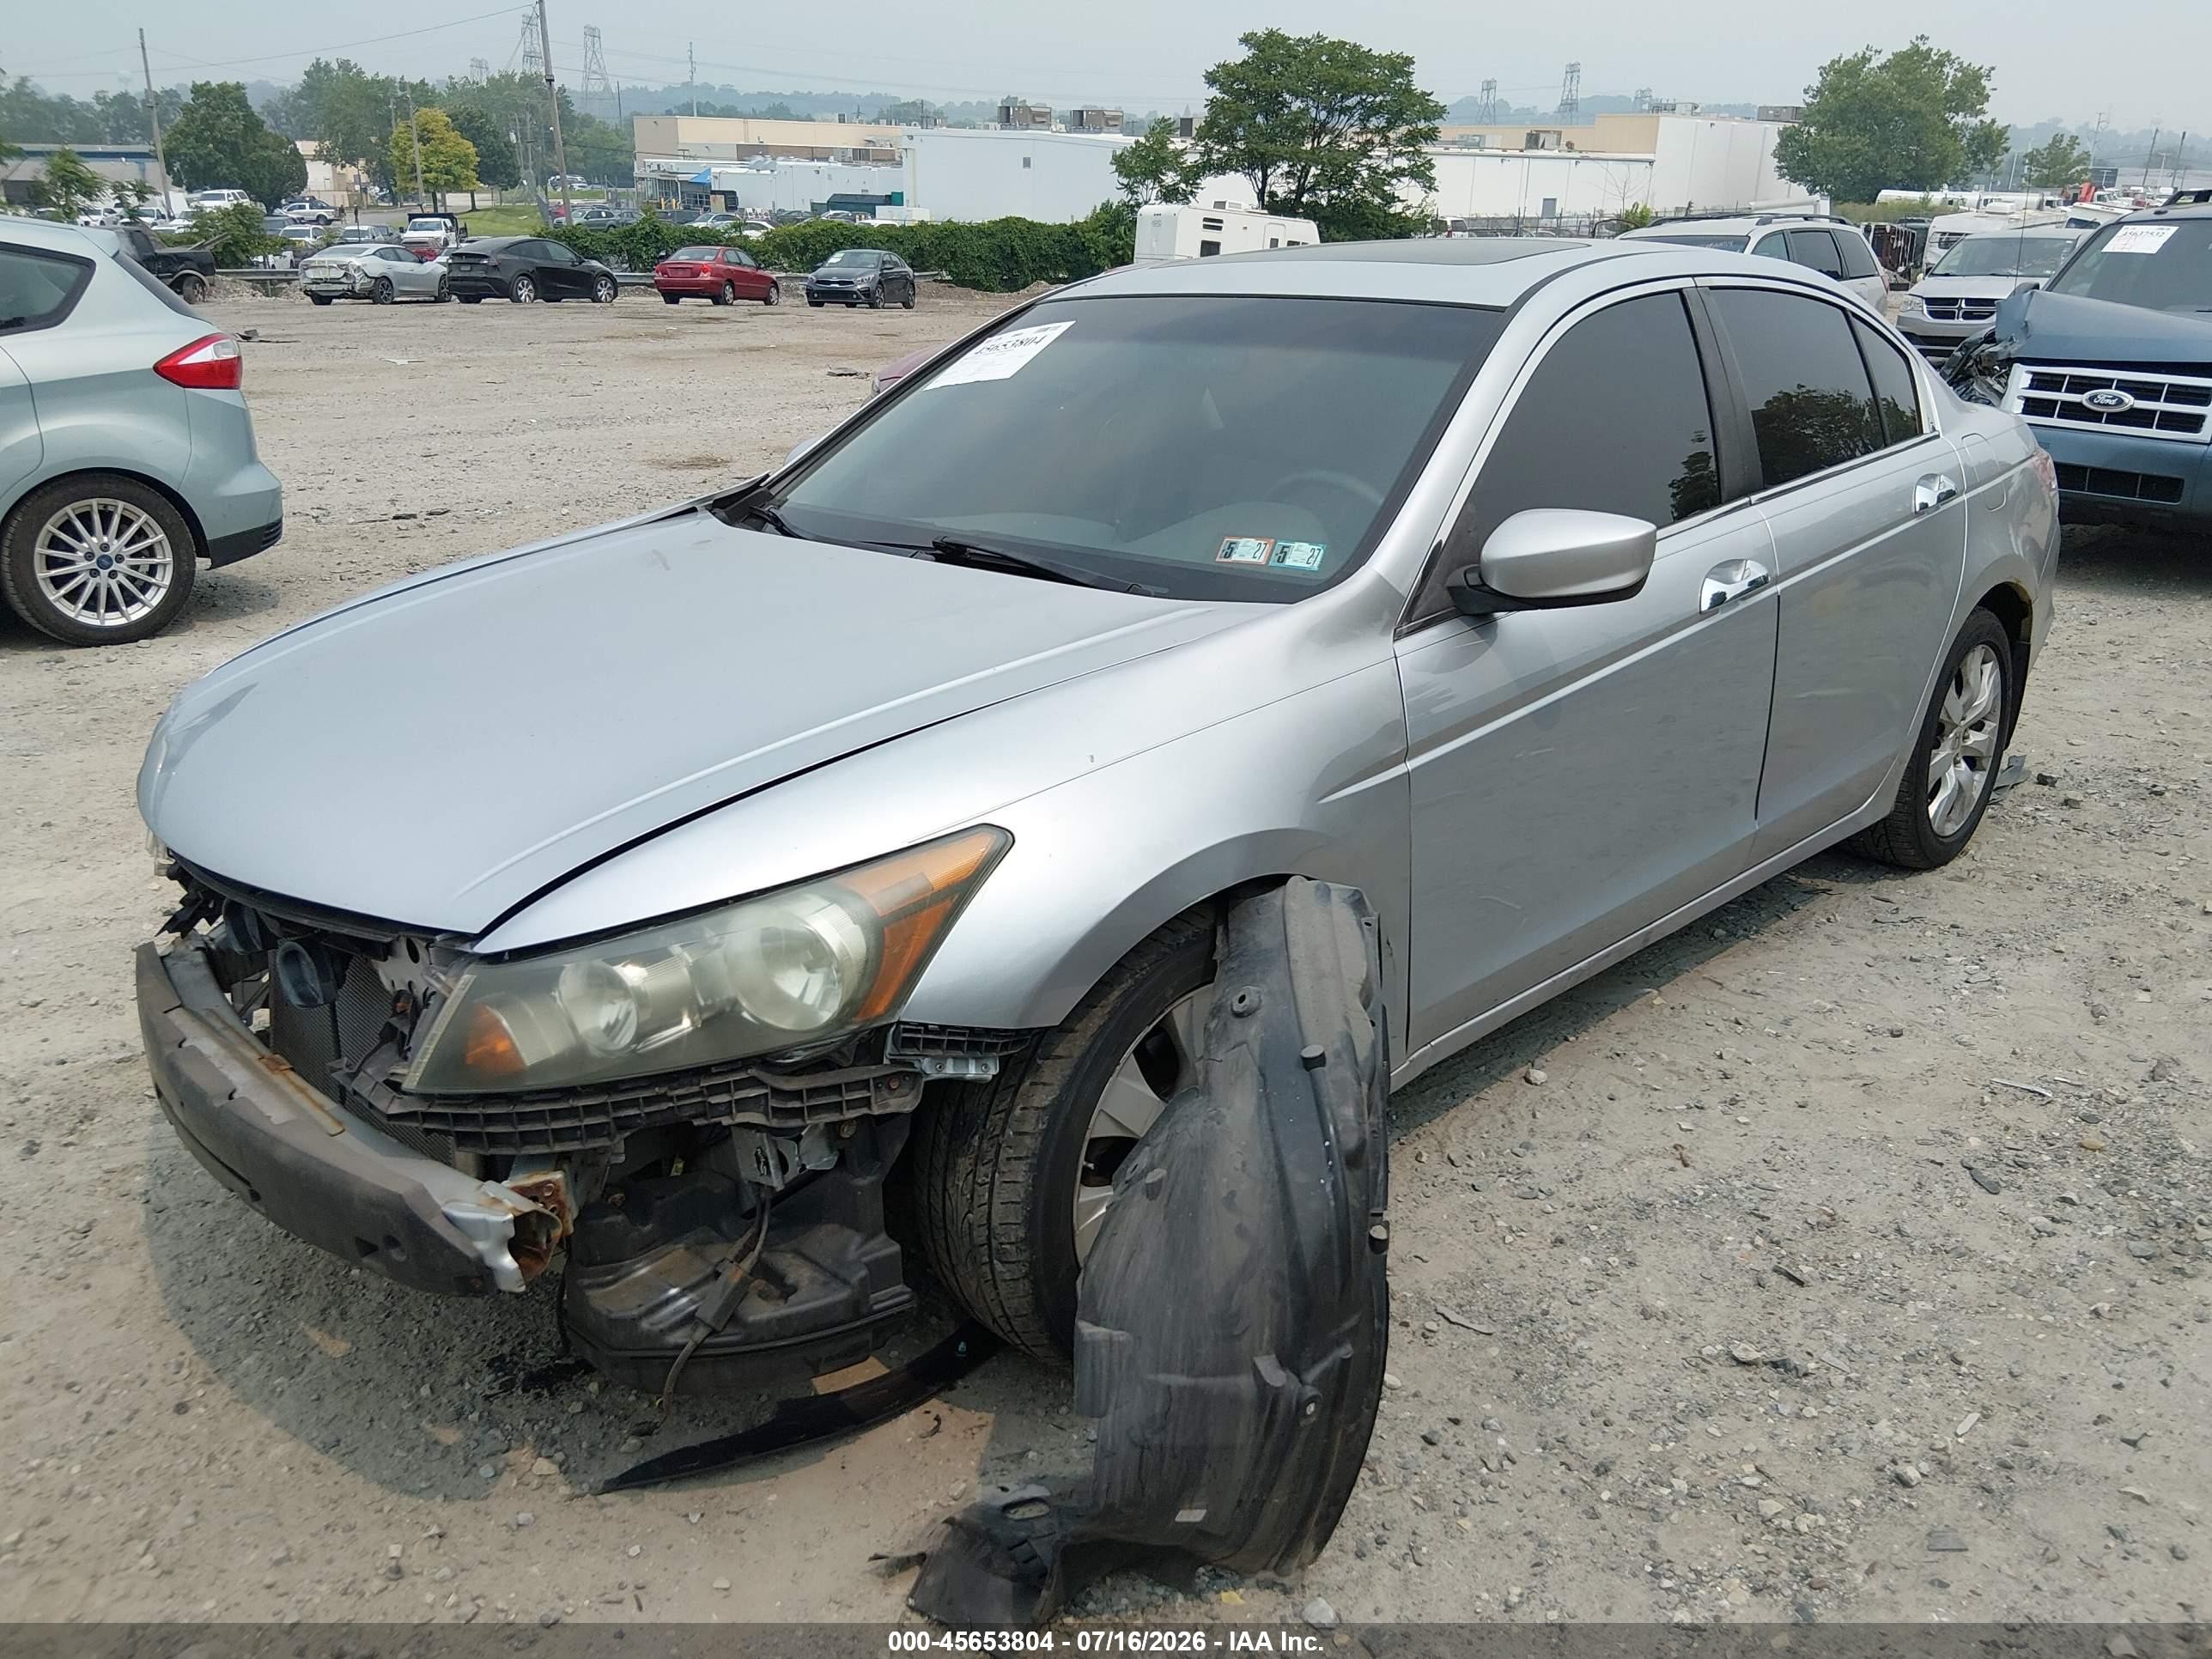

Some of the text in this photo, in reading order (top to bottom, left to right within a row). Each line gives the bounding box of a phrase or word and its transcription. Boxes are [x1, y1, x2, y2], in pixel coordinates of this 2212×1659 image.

[2094, 393, 2118, 405] Ford
[1252, 542, 1268, 561] 27
[1306, 547, 1322, 567] 27
